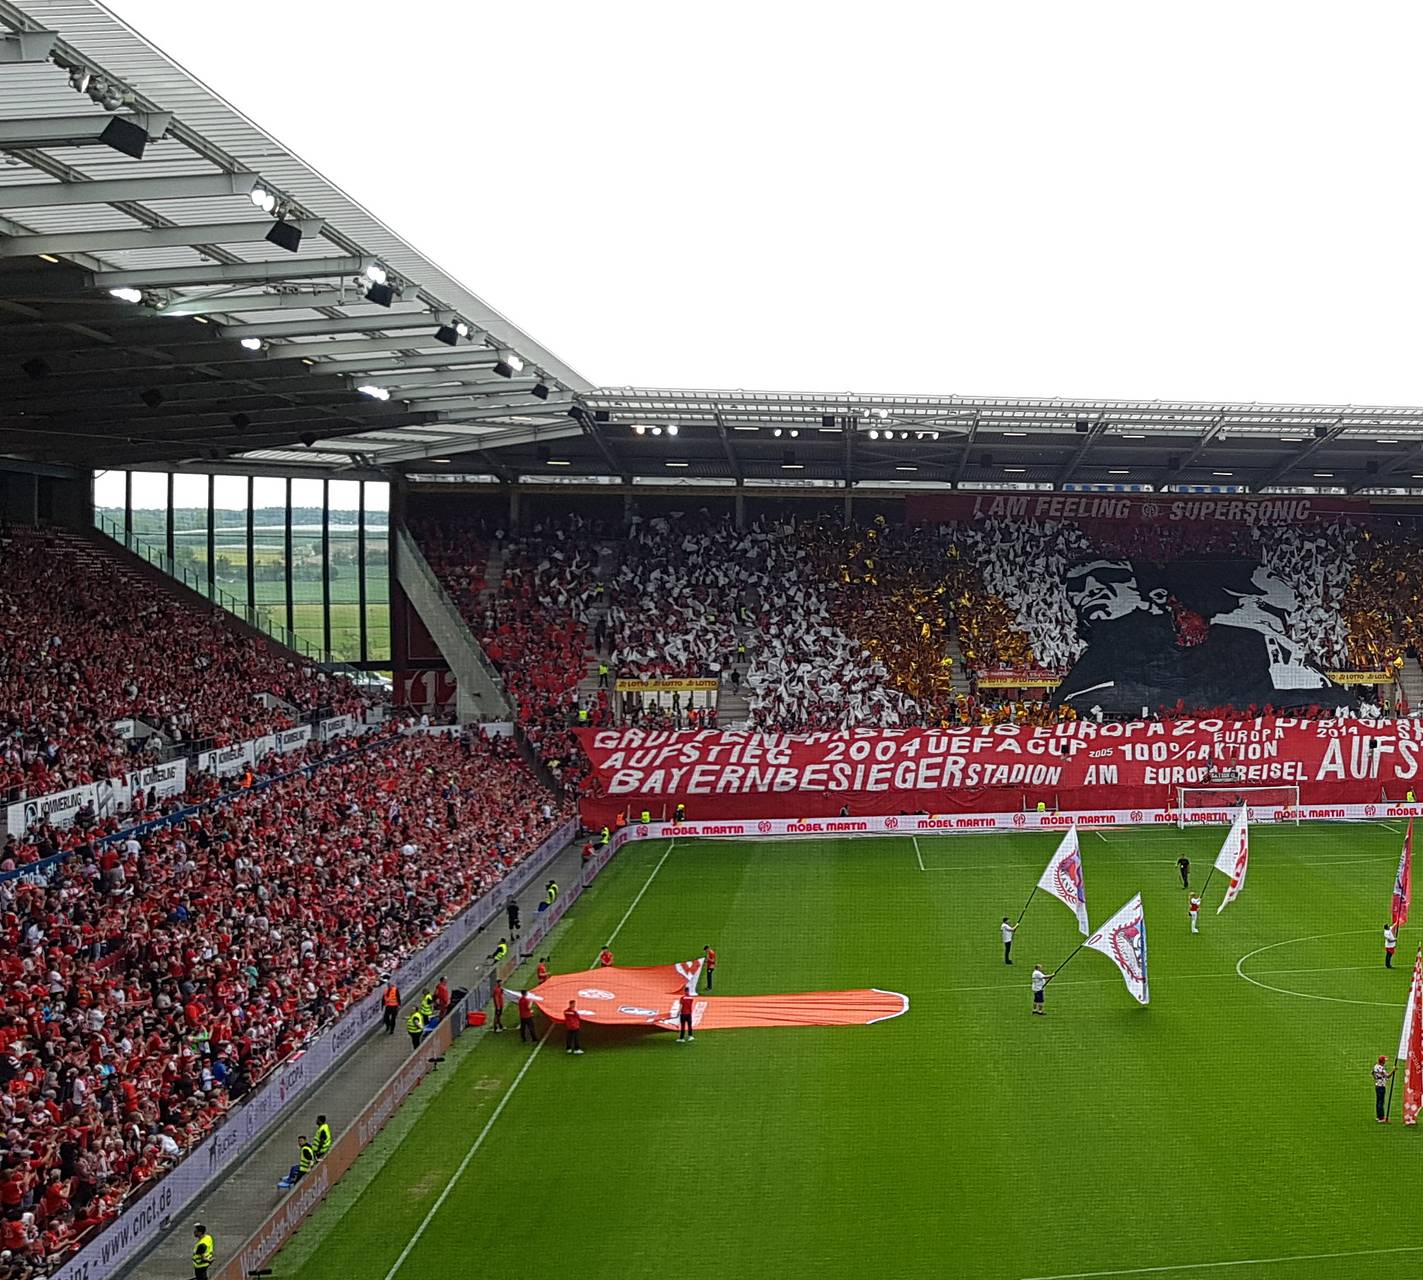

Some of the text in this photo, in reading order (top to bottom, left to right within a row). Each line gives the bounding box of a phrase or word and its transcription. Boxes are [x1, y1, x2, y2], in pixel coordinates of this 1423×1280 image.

[988, 497, 1027, 515] AM
[1034, 497, 1130, 519] FEELING
[1169, 499, 1312, 521] SUPERSONIC
[1213, 727, 1285, 744] EUROPA
[1315, 727, 1360, 739] 2014
[599, 742, 792, 769] AUFSTIEG
[822, 737, 921, 762] 2004
[1088, 747, 1113, 758] 2005
[965, 763, 1062, 786] STADION
[1084, 764, 1119, 785] AM
[1077, 815, 1116, 824] MARTIN
[1308, 809, 1345, 818] MARTIN
[826, 821, 867, 831] MARTIN
[956, 818, 996, 828] MARTIN
[702, 825, 745, 836] MARTIN
[101, 1186, 172, 1266] www.cnct.de
